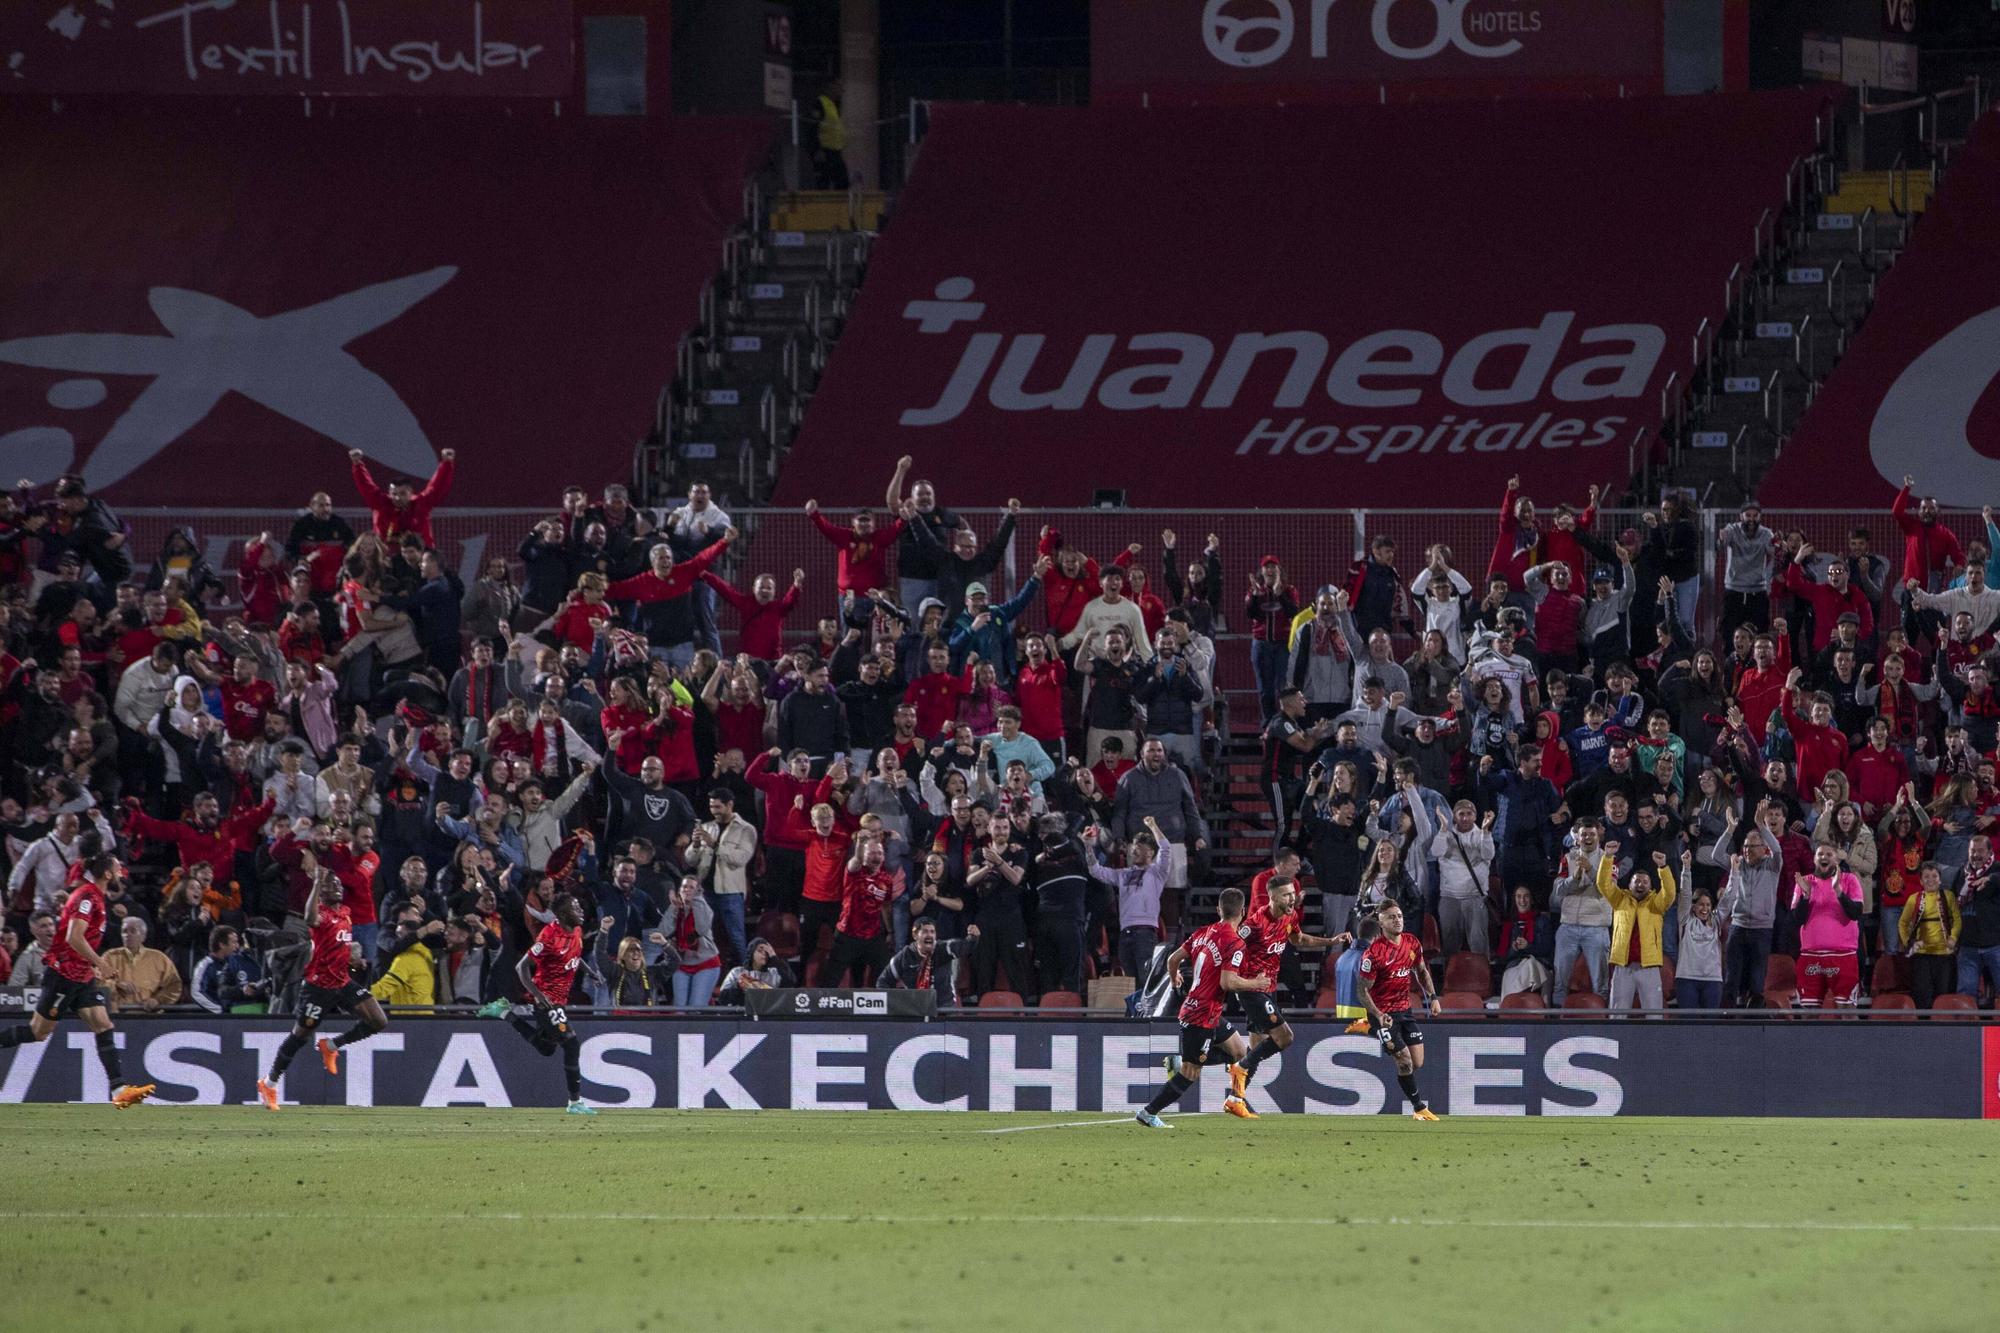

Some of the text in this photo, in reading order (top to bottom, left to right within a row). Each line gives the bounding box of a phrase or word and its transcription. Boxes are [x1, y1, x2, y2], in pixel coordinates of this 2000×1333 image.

[1470, 11, 1542, 33] HOTELS
[136, 0, 543, 83] Textil Insular
[899, 277, 1667, 427] juaneda
[1235, 412, 1628, 464] Hospitales
[53, 992, 66, 1008] 7
[1265, 1000, 1275, 1014] 6
[305, 1002, 322, 1020] 12
[548, 1007, 567, 1026] 23
[1376, 1027, 1392, 1044] 15
[1200, 1038, 1212, 1055] 4
